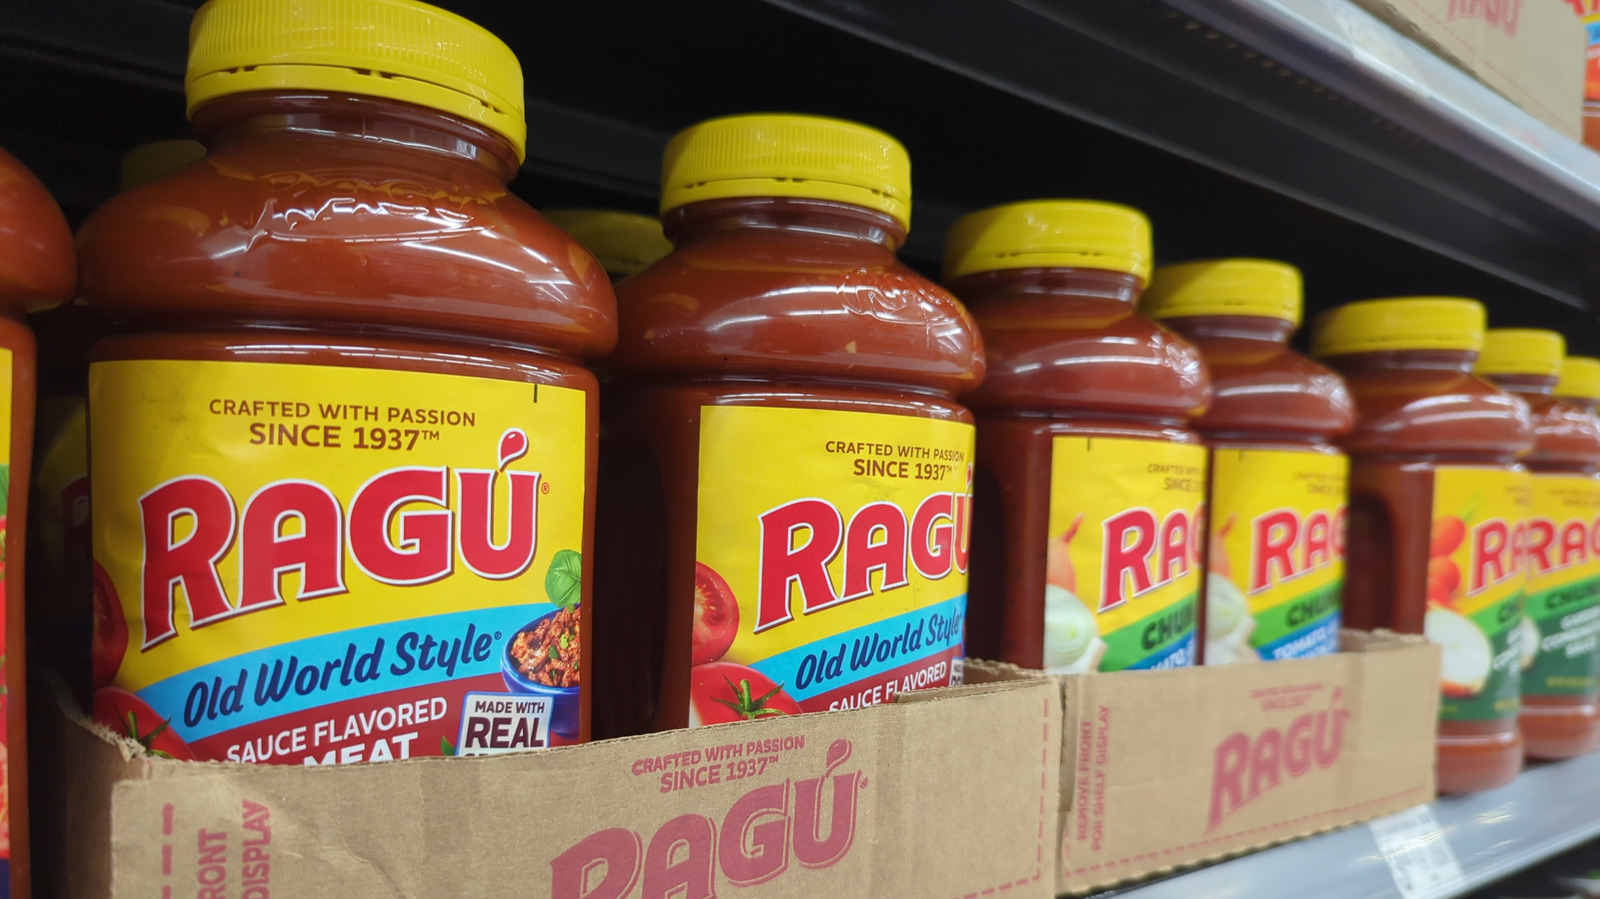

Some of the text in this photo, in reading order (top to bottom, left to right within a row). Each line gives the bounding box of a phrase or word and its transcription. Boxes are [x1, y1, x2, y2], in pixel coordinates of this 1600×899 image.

[209, 399, 476, 427] CRAFTED WITH PASSION
[250, 422, 342, 448] SINCE
[825, 441, 965, 463] CRAFTED WITH PASSION
[853, 458, 909, 479] SINCE
[795, 643, 847, 690] Old
[850, 618, 925, 671] World
[183, 668, 248, 728] Old
[254, 637, 386, 707] World
[829, 661, 947, 713] SAUCE FLAVORED
[475, 700, 545, 714] MADE WITH
[227, 696, 448, 764] SAUCE FLAVORED
[465, 716, 545, 749] REAL
[1096, 704, 1110, 766] DISPLAY
[631, 735, 806, 776] CRAFTED WITH PASSION
[660, 763, 722, 793] SINCE
[1076, 721, 1093, 841] REMOVE FRONT
[242, 798, 271, 899] DISPLAY
[1091, 820, 1104, 851] FOR
